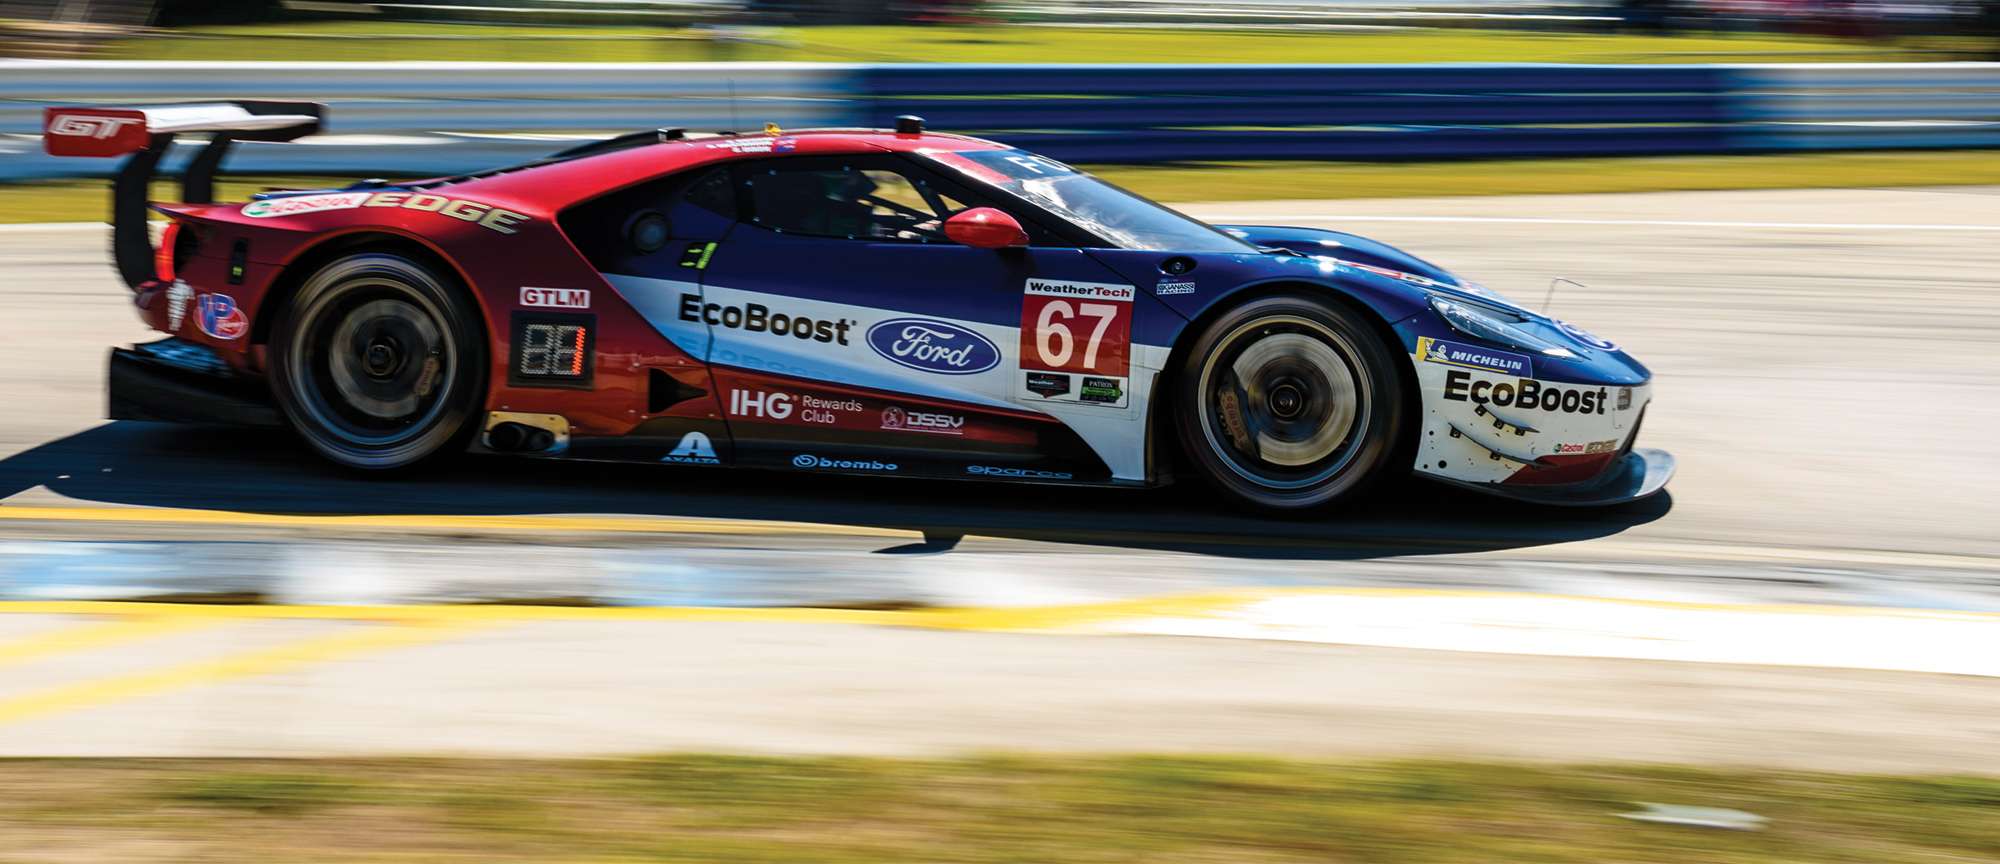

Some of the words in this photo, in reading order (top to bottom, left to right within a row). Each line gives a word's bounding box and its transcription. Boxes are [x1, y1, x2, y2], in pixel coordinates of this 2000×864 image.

[48, 114, 144, 139] GT
[362, 192, 531, 235] EDGE
[525, 289, 585, 306] GTLM
[1029, 281, 1130, 298] WeatherTech
[678, 293, 850, 347] EcoBoost
[1036, 300, 1118, 369] 67
[891, 325, 973, 367] Ford
[1451, 350, 1522, 370] MICHELIN
[1443, 370, 1608, 415] EcoBoost
[730, 389, 793, 419] IHG
[802, 395, 863, 412] Rewards
[801, 409, 835, 424] Club
[906, 411, 965, 428] DSSV
[660, 456, 721, 464] AXALTA
[819, 457, 898, 470] brembo
[966, 465, 1073, 479] sparco
